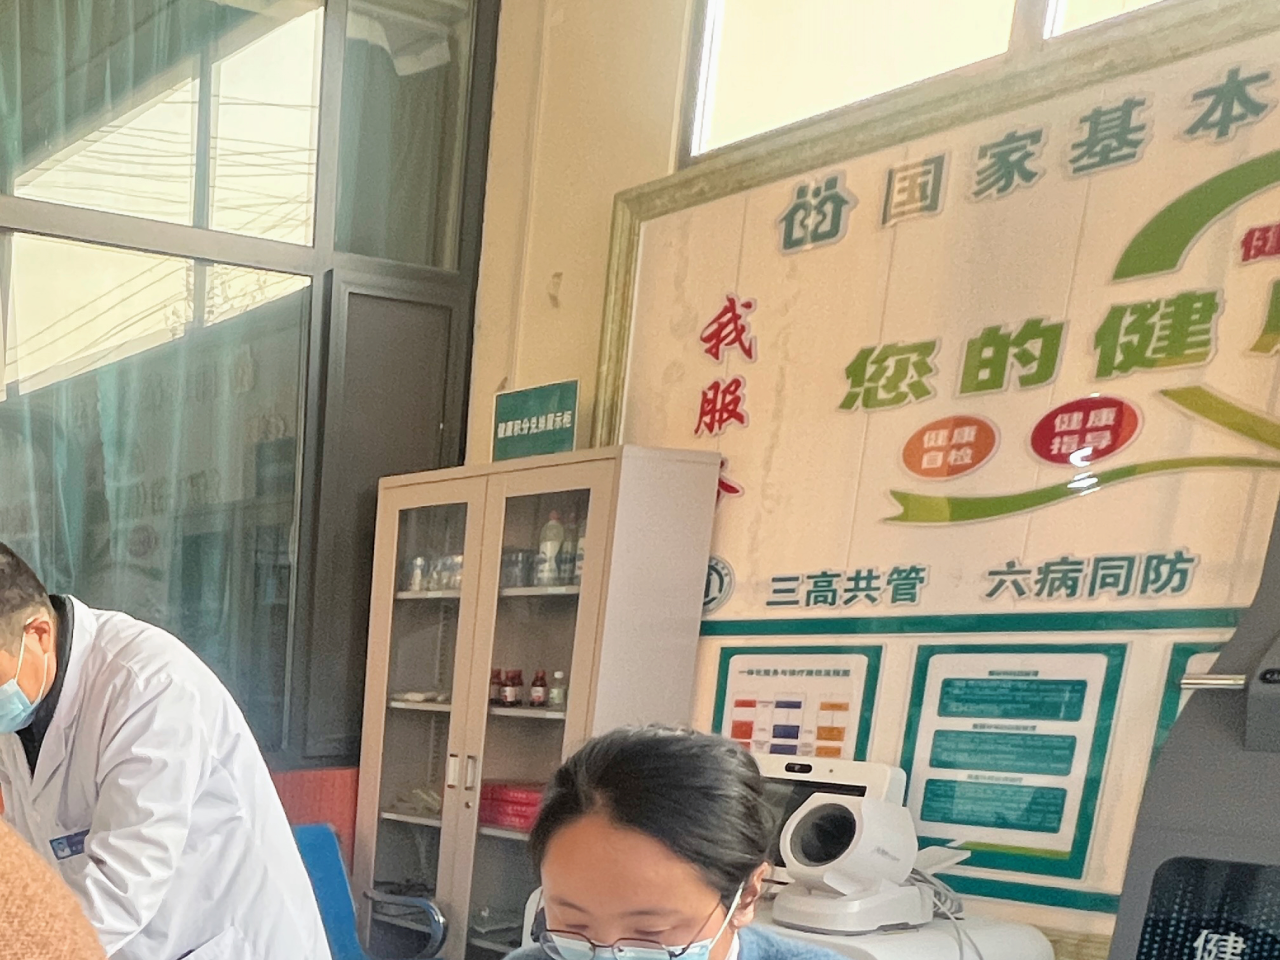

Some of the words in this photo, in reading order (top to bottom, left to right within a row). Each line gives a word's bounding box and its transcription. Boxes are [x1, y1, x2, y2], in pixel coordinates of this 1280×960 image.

[883, 67, 1271, 226] 国家基本
[839, 281, 1280, 411] 您的健
[1055, 407, 1118, 432] 健康
[923, 425, 978, 448] 健康
[1050, 430, 1112, 455] 指导
[921, 447, 973, 470] 自检
[766, 565, 927, 608] 三高共管
[986, 552, 1197, 599] 六病同防
